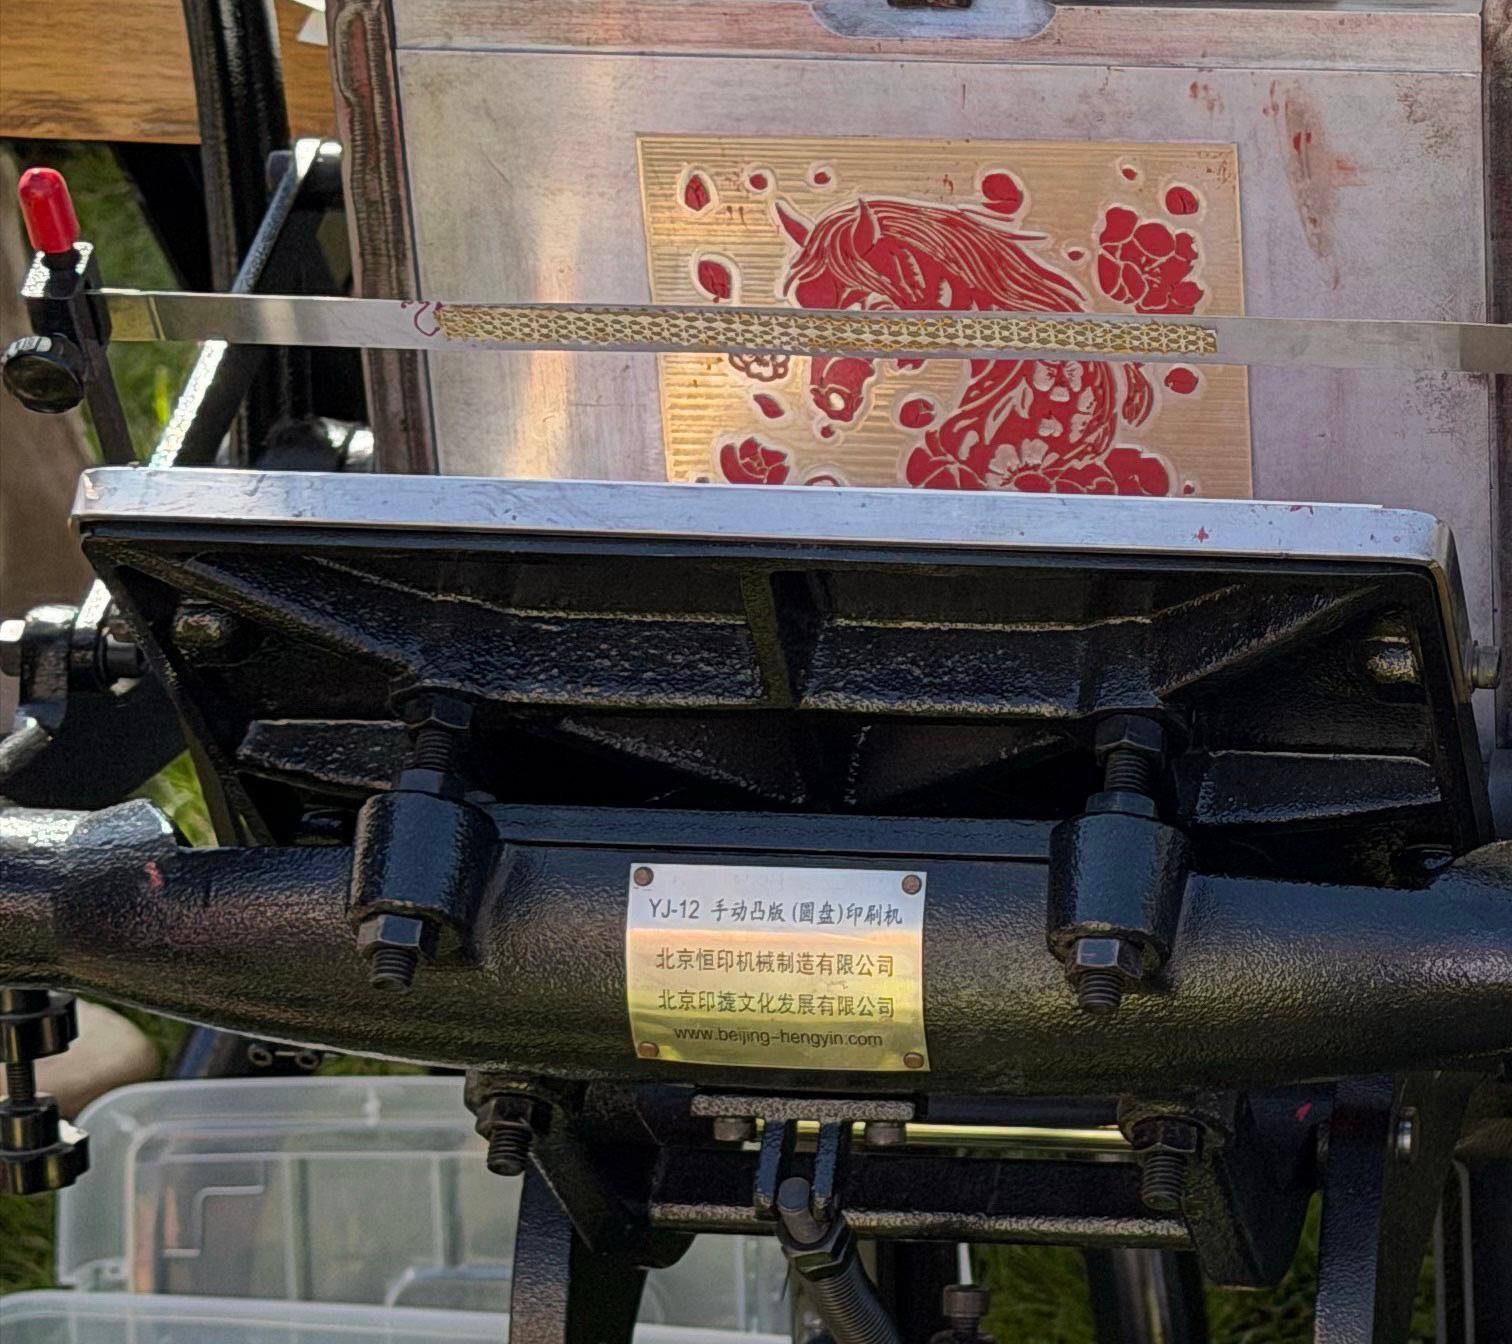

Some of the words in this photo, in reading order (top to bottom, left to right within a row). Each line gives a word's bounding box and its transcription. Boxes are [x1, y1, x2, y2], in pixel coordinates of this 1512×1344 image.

[648, 898, 700, 920] YJ-12
[655, 946, 895, 977] 北京恒印机械制造有限公司
[657, 988, 896, 1018] 北京印捷文化发展有限公司
[673, 1025, 883, 1048] www.beijing-hengyin.com
